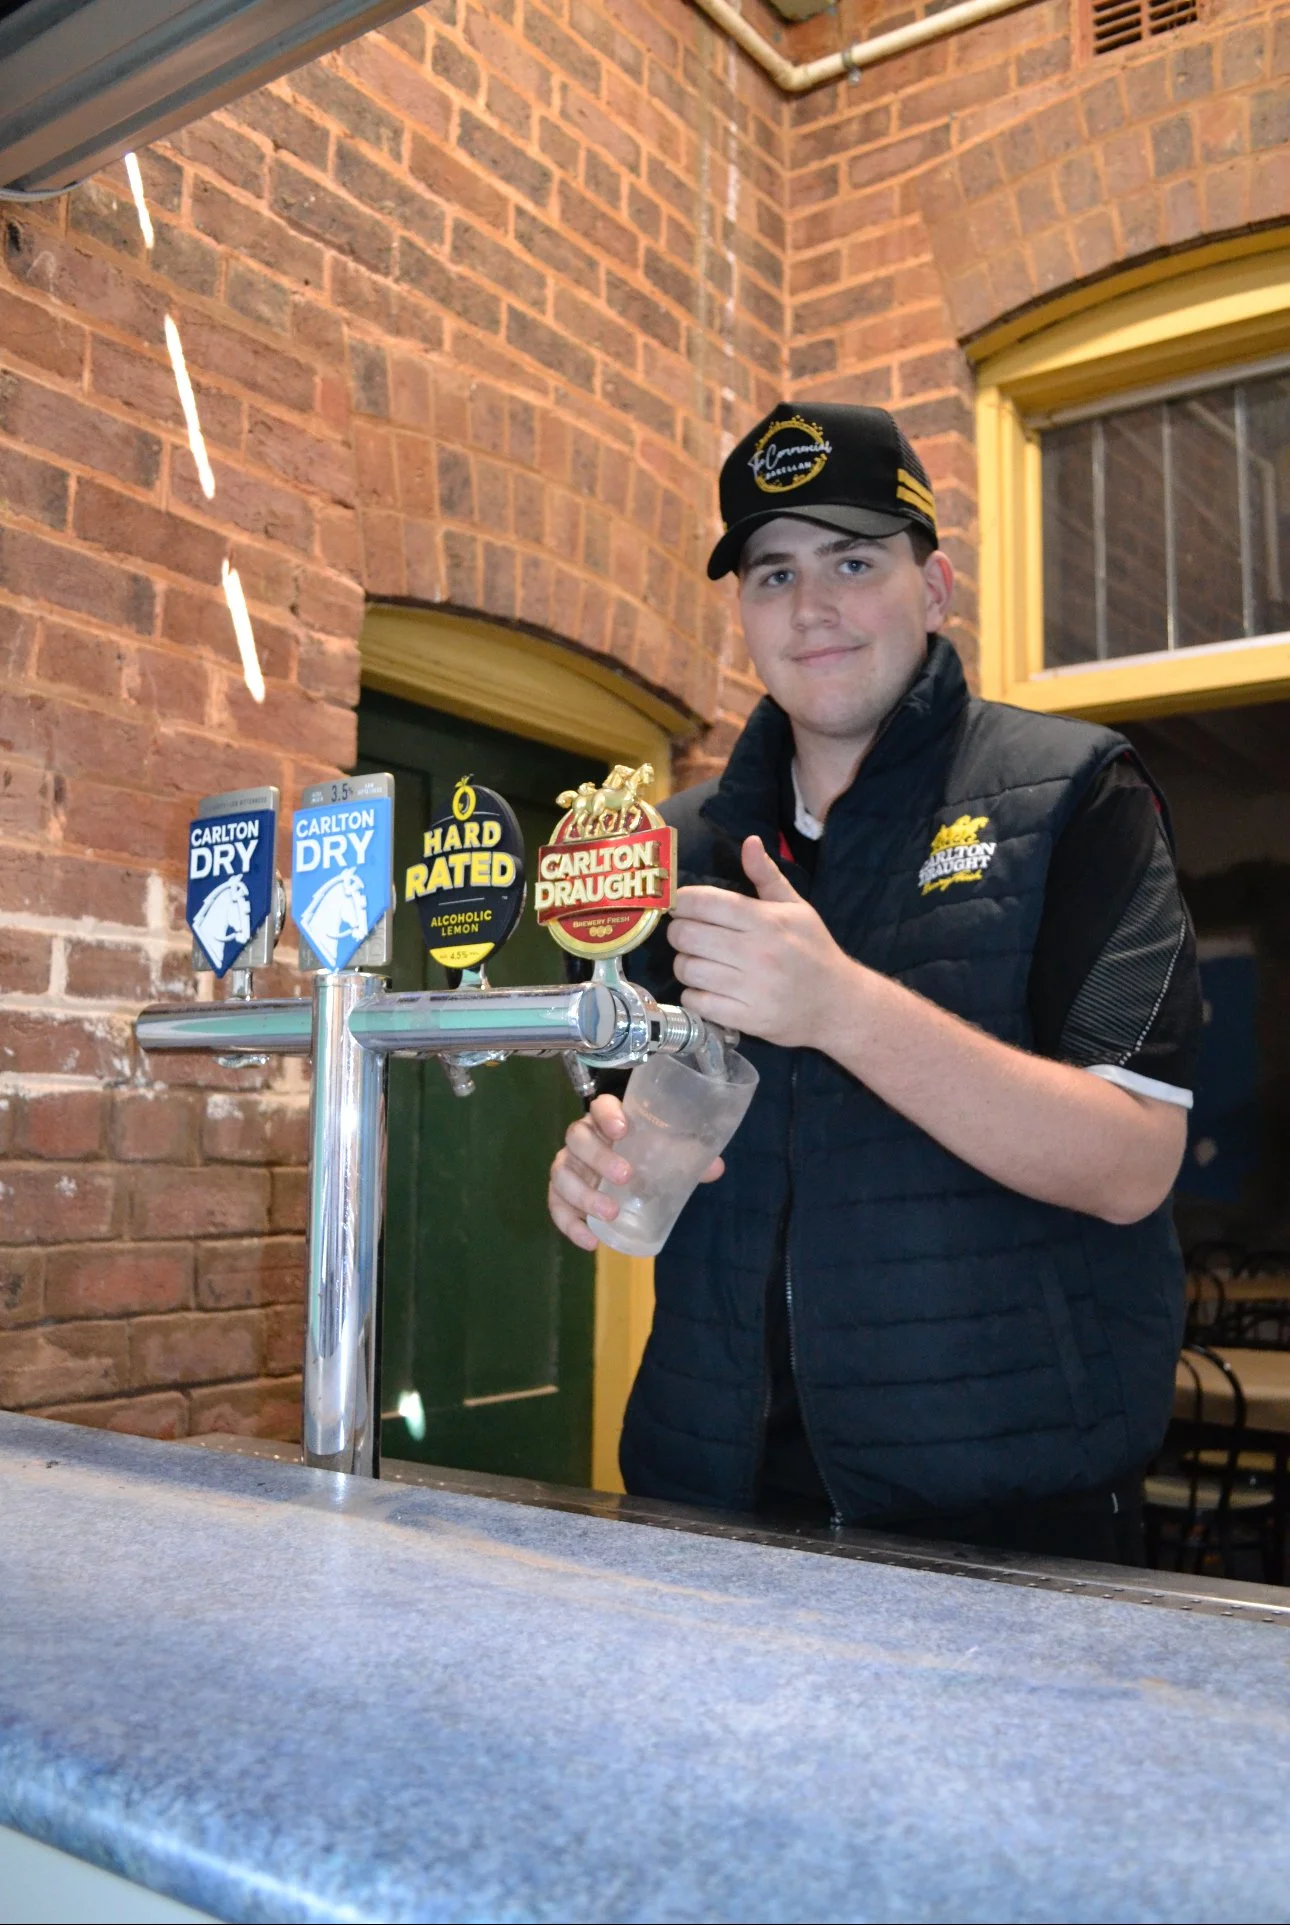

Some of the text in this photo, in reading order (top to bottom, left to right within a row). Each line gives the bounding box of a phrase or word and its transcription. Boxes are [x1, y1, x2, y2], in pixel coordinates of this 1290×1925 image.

[191, 820, 259, 846] CARLTON
[296, 809, 375, 838] CARLTON
[423, 820, 502, 858] HARD
[190, 839, 259, 880] DRY
[295, 830, 375, 873] DRY
[541, 841, 658, 880] CARLTON
[405, 852, 516, 902] RATED
[534, 868, 664, 911] DRAUGHT
[431, 910, 492, 927] ALCOHOLIC
[441, 923, 479, 937] LEMON
[573, 916, 630, 928] BREWERY FRESH
